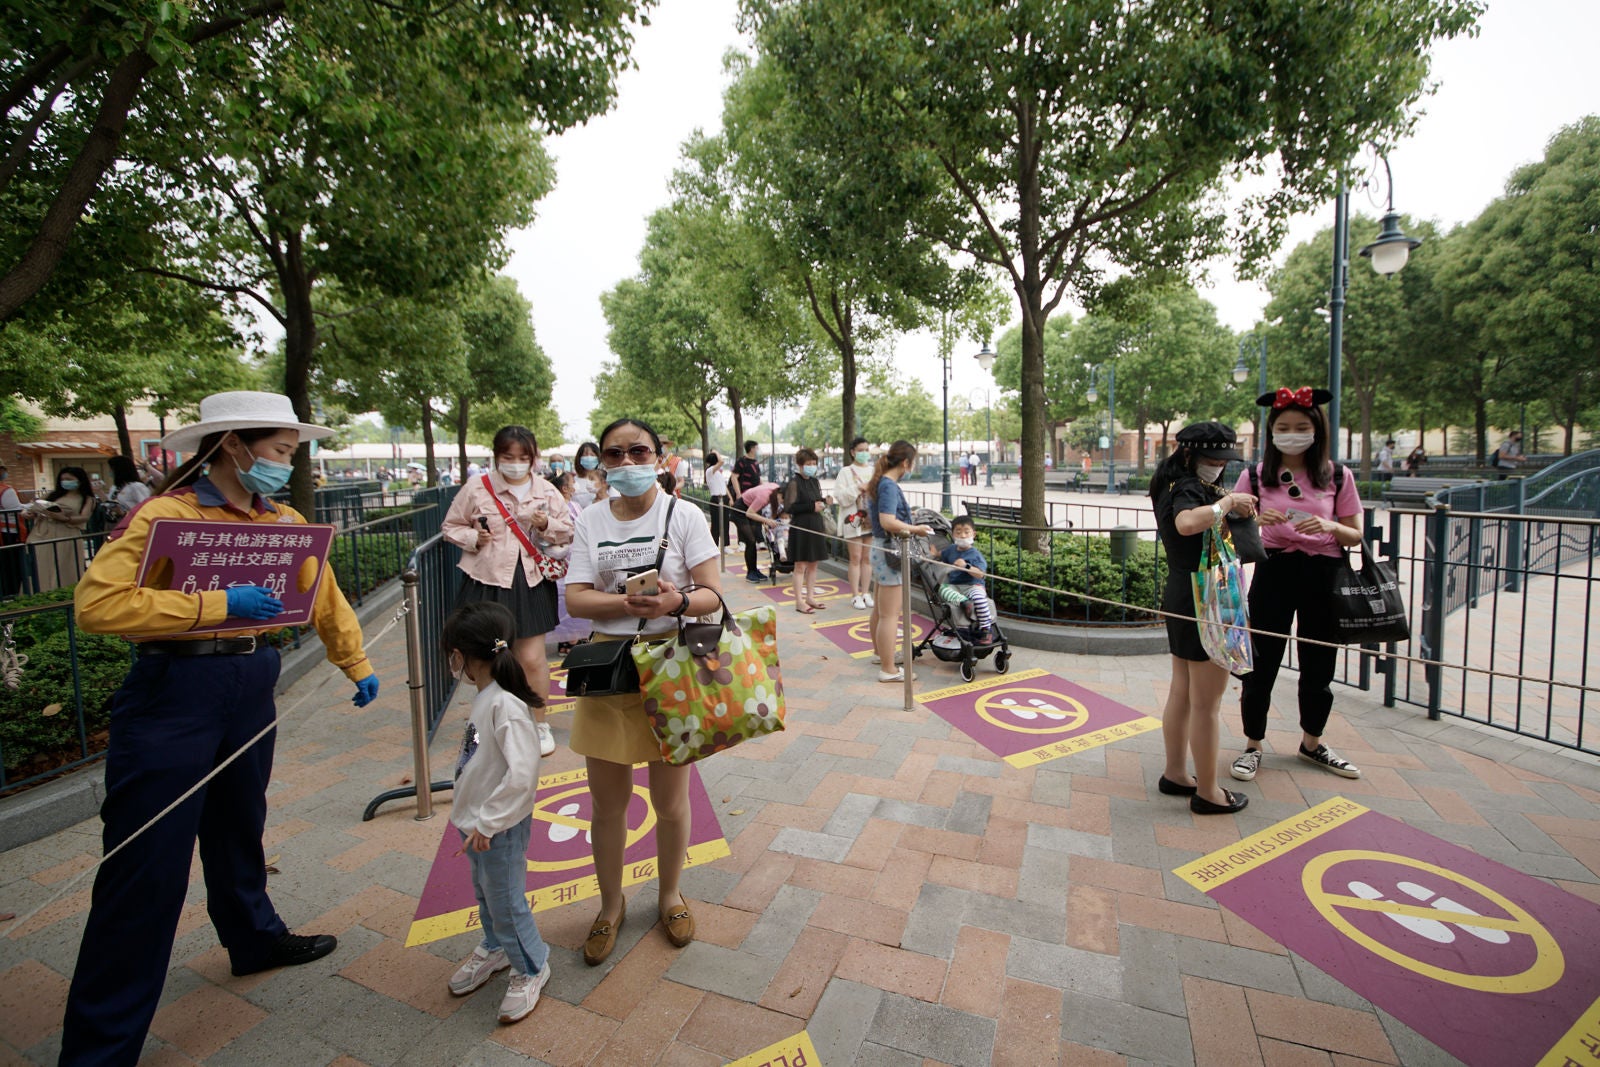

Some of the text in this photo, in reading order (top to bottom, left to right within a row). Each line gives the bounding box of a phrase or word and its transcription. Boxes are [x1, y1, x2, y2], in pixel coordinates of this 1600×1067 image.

[177, 531, 313, 548] 请与其他游客保持
[190, 552, 295, 567] 适当社交距离
[1191, 801, 1358, 883] PLEASE DO NOT STAND HERE
